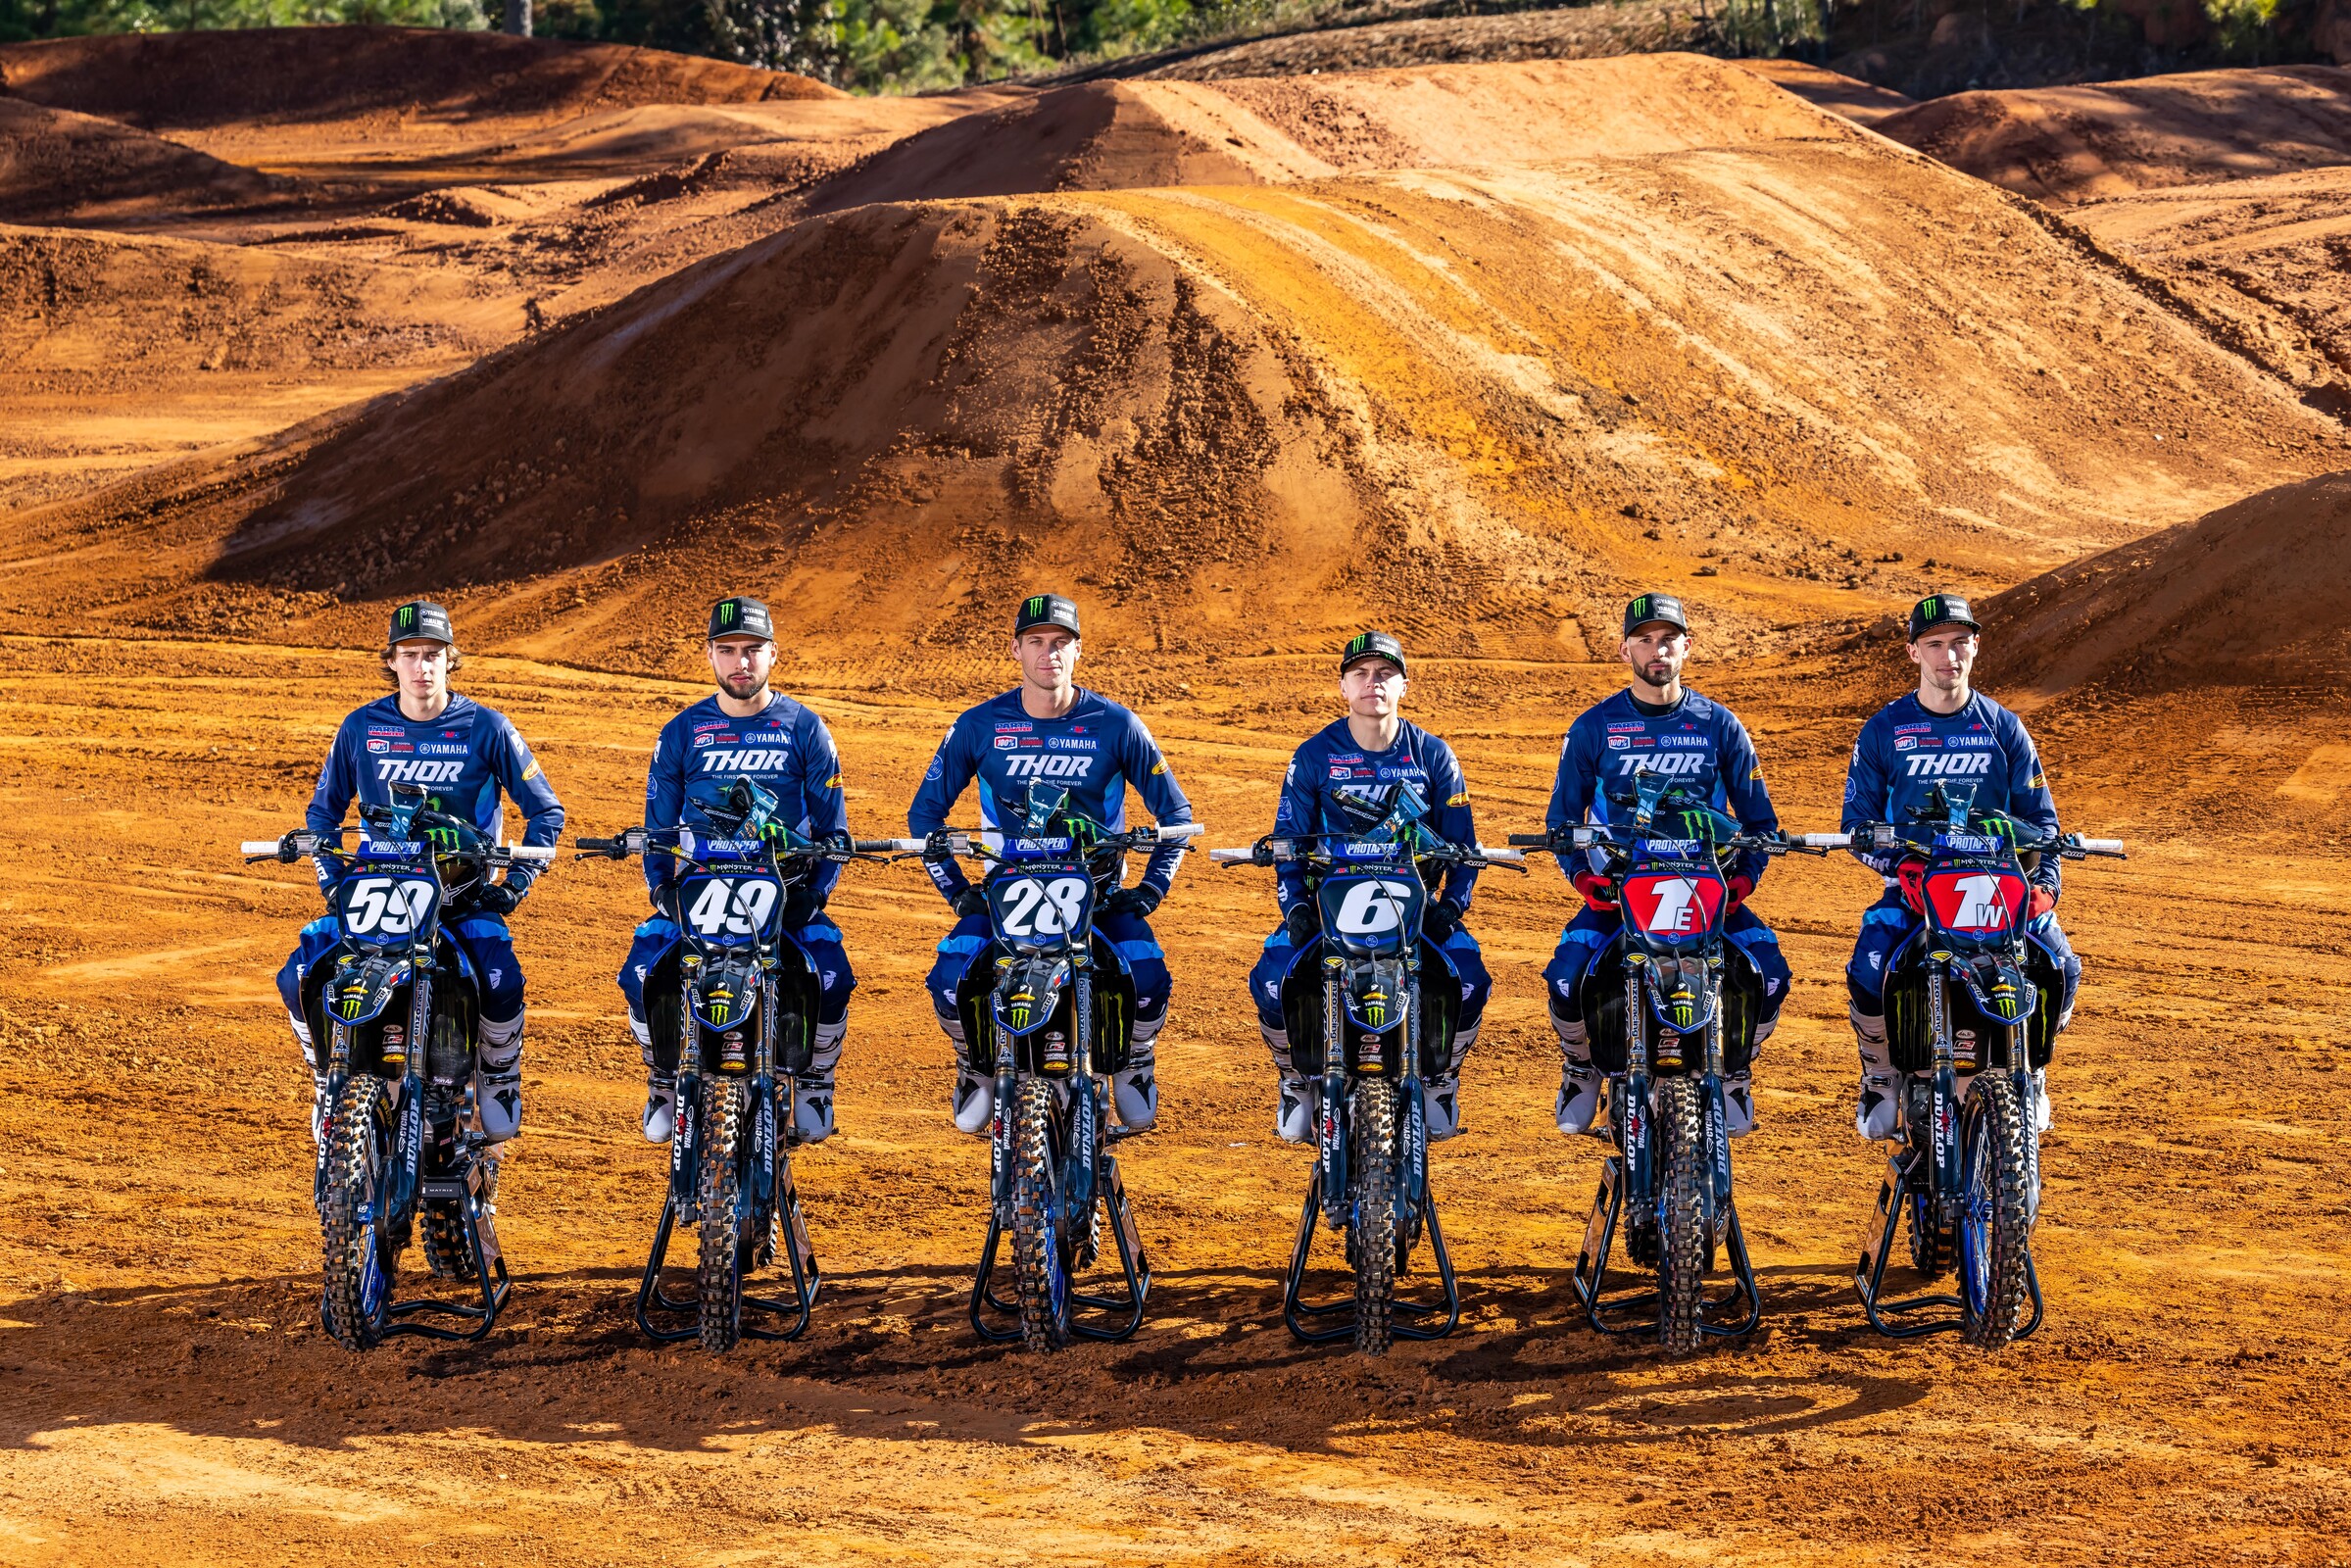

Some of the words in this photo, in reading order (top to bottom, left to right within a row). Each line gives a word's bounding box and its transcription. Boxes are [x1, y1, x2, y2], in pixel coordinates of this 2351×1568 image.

[694, 719, 729, 729] PARTS
[1894, 722, 1931, 731] PARTS
[368, 742, 386, 751] 100%
[431, 744, 468, 755] YAMAHA
[1059, 738, 1097, 750] YAMAHA
[1671, 736, 1708, 746] YAMAHA
[1958, 736, 1994, 747] YAMAHA
[377, 759, 465, 782] THOR
[702, 749, 789, 772] THOR
[1005, 755, 1093, 777] THOR
[1618, 753, 1705, 775] THOR
[1905, 753, 1992, 776] THOR
[345, 878, 435, 934] 59
[688, 878, 778, 934] 49
[1003, 877, 1088, 936] 28
[1336, 880, 1412, 934] 6
[399, 1109, 409, 1138] CYCRA
[406, 1098, 420, 1176] DUNLOP
[763, 1097, 773, 1176] DUNLOP
[994, 1097, 1003, 1172] DULOP
[1082, 1093, 1094, 1171] DUNLOP
[1712, 1097, 1727, 1176] DUNLOP
[1934, 1091, 1945, 1168] DUNLOP
[2026, 1096, 2038, 1175] DUNLOP
[1411, 1100, 1423, 1178] DUNLOP
